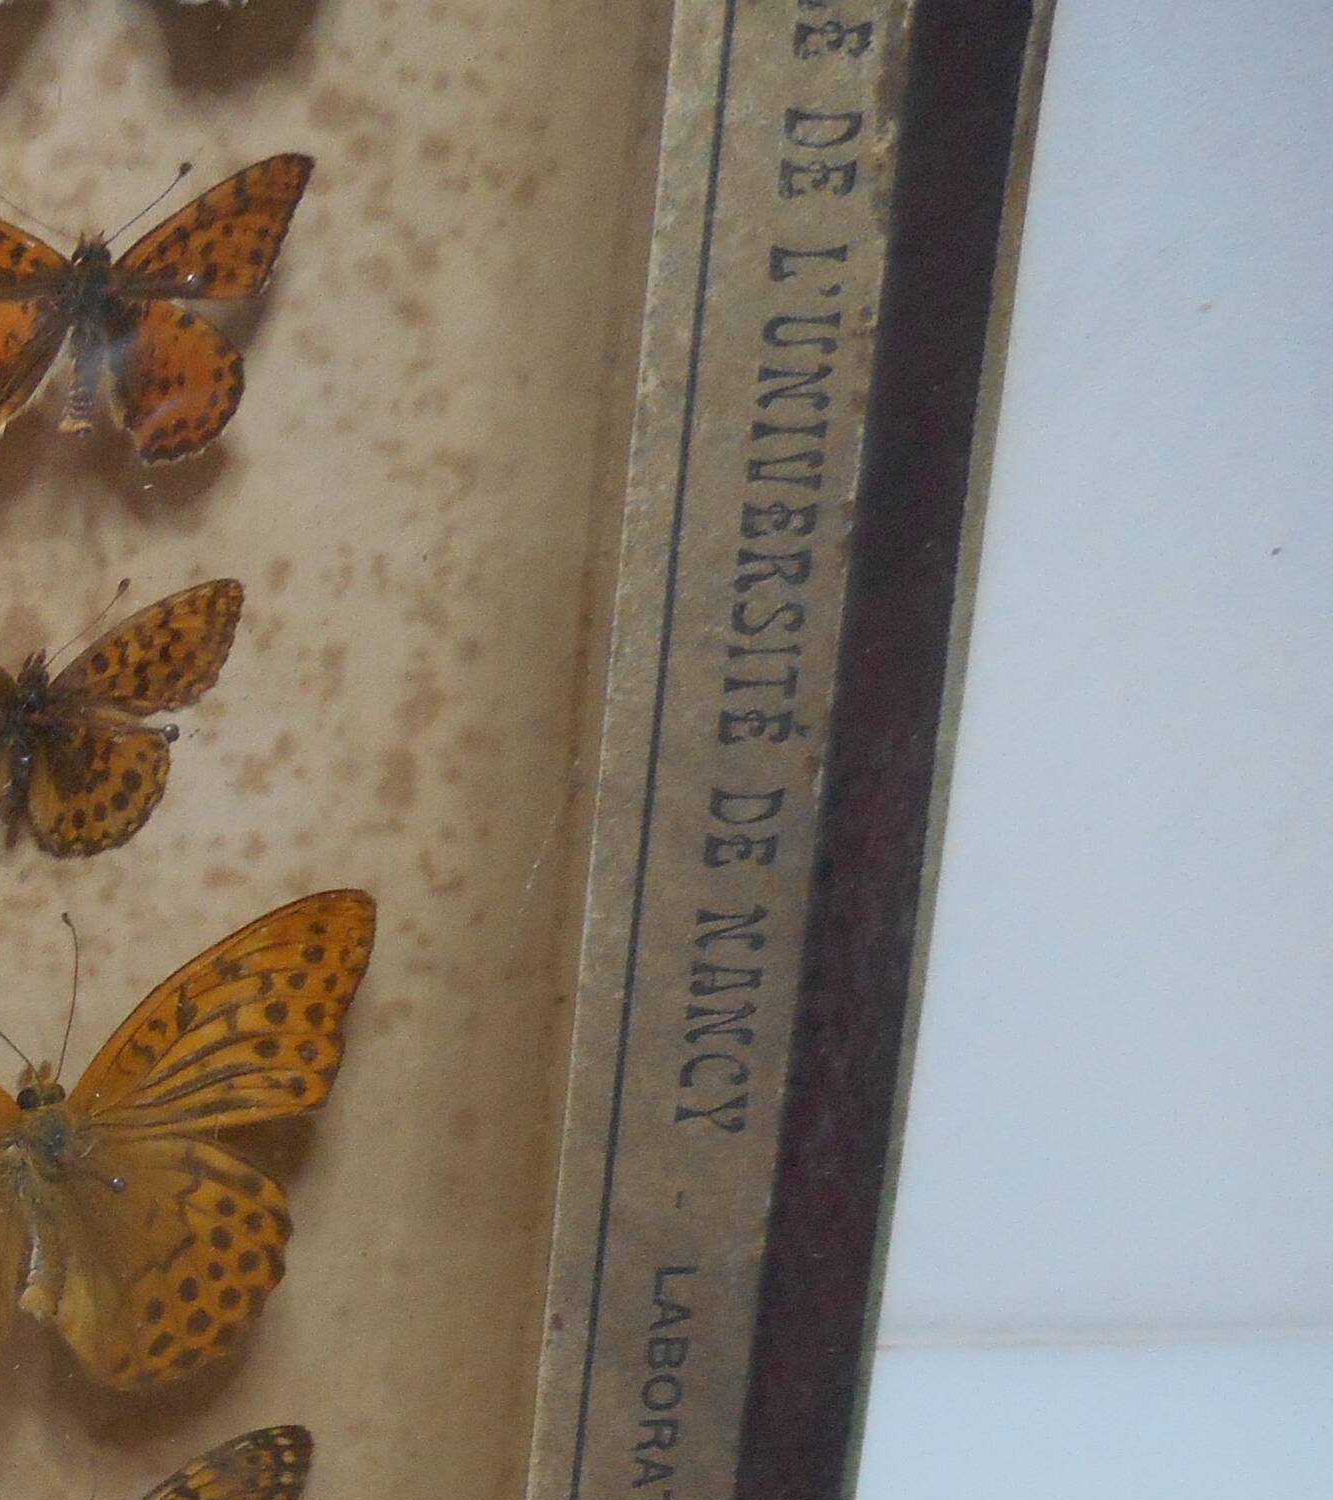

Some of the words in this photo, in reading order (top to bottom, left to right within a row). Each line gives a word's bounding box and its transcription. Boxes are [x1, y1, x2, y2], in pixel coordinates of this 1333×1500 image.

[792, 0, 874, 60] E
[779, 107, 864, 200] DE
[717, 244, 848, 746] L'UNIVERSITÉ
[702, 786, 786, 868] DE
[673, 904, 769, 1134] NANCY
